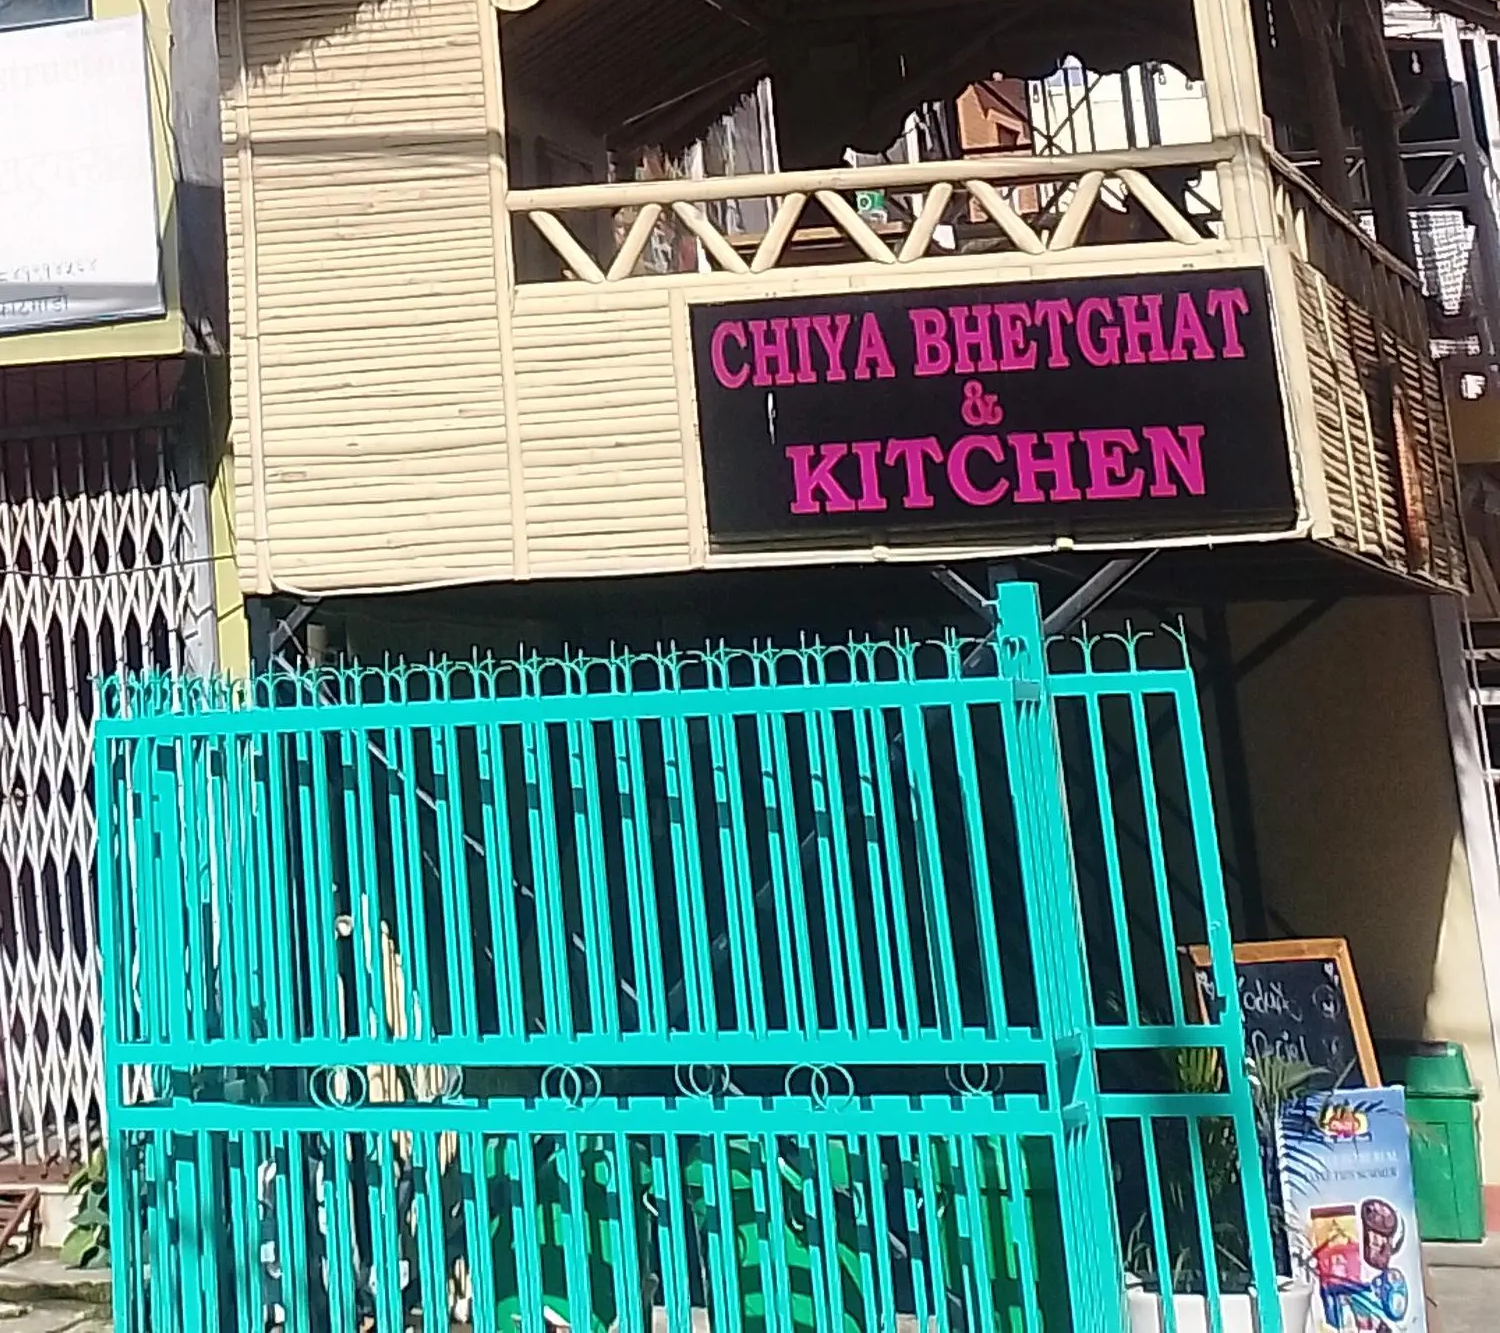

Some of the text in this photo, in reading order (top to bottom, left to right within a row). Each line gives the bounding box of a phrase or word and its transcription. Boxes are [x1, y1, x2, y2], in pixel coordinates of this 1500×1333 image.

[710, 288, 1250, 389] CHIYA BHETGHAT
[960, 378, 1003, 426] &
[784, 424, 1206, 515] KITCHEN
